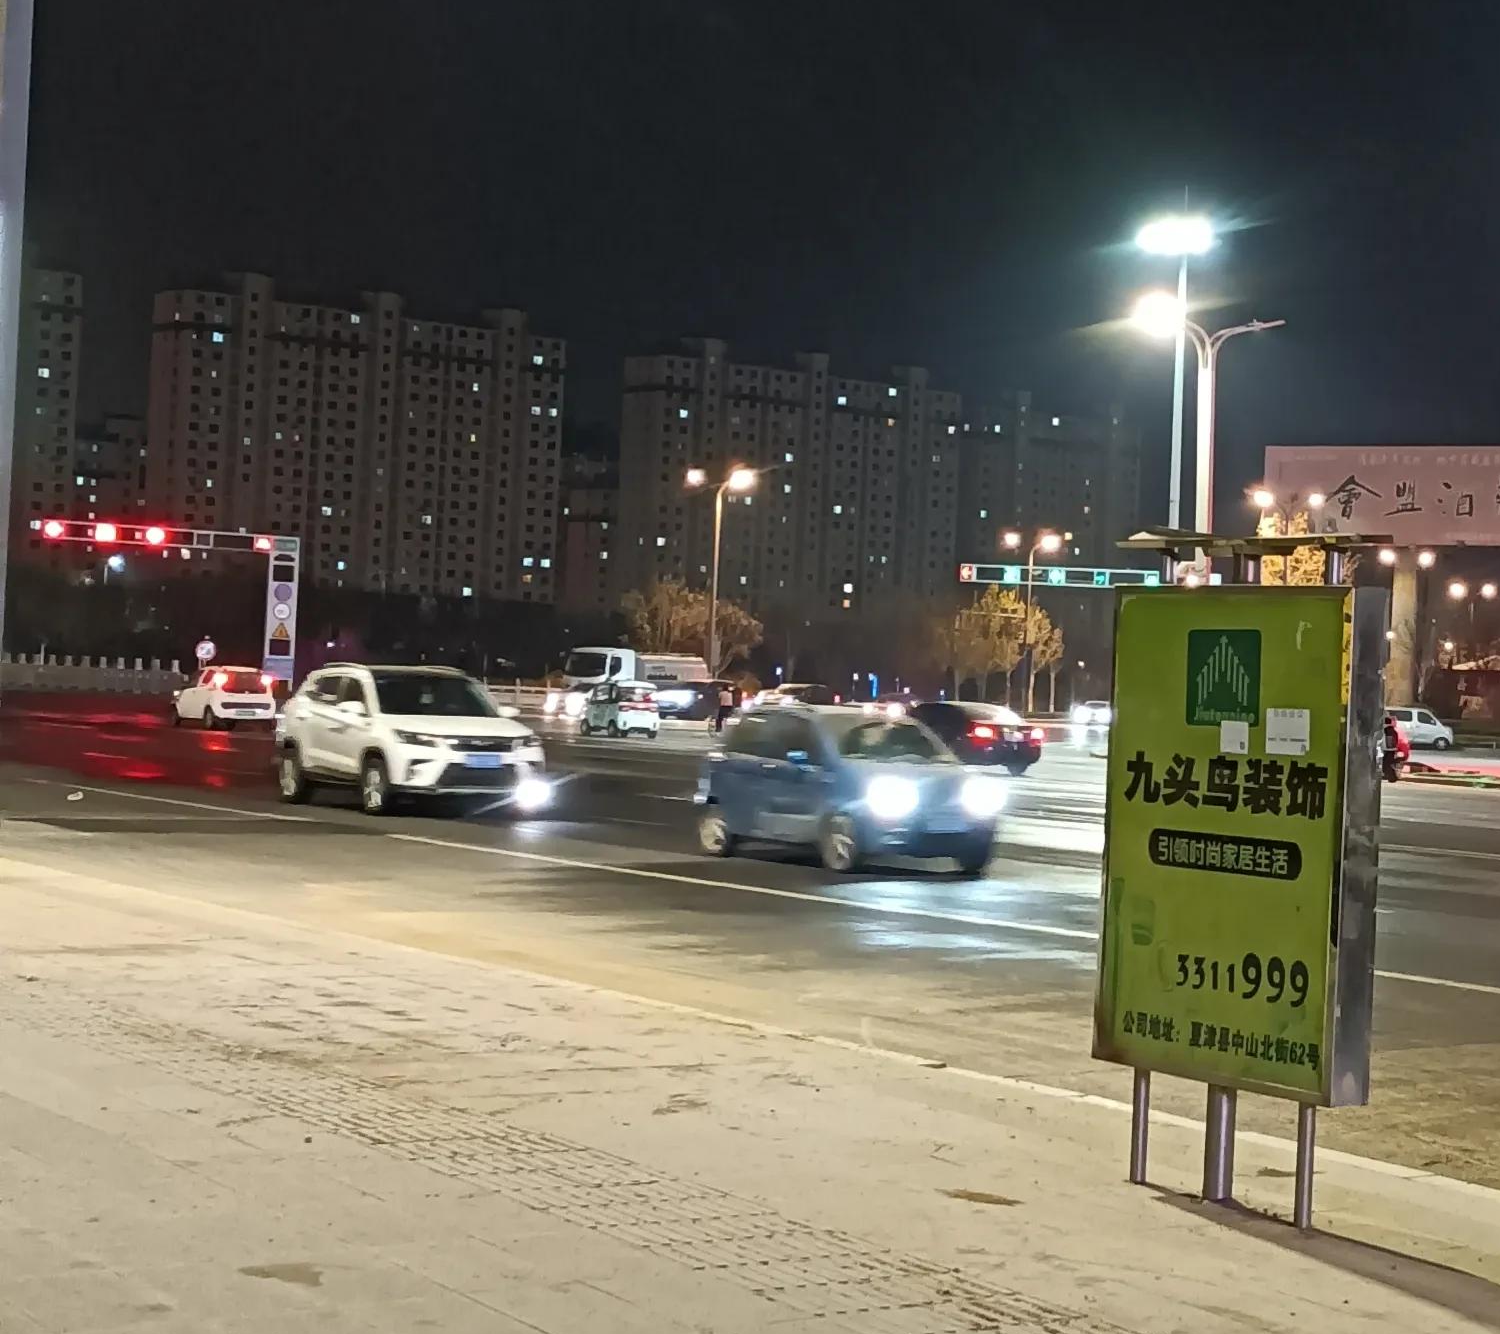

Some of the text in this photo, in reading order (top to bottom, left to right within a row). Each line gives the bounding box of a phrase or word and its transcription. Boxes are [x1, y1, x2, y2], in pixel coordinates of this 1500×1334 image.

[1124, 751, 1328, 820] 九头鸟装饰
[1158, 835, 1289, 875] 引领时尚家居生活
[1176, 952, 1310, 1008] 3311999
[1189, 1021, 1321, 1070] 夏津县中山北街62号
